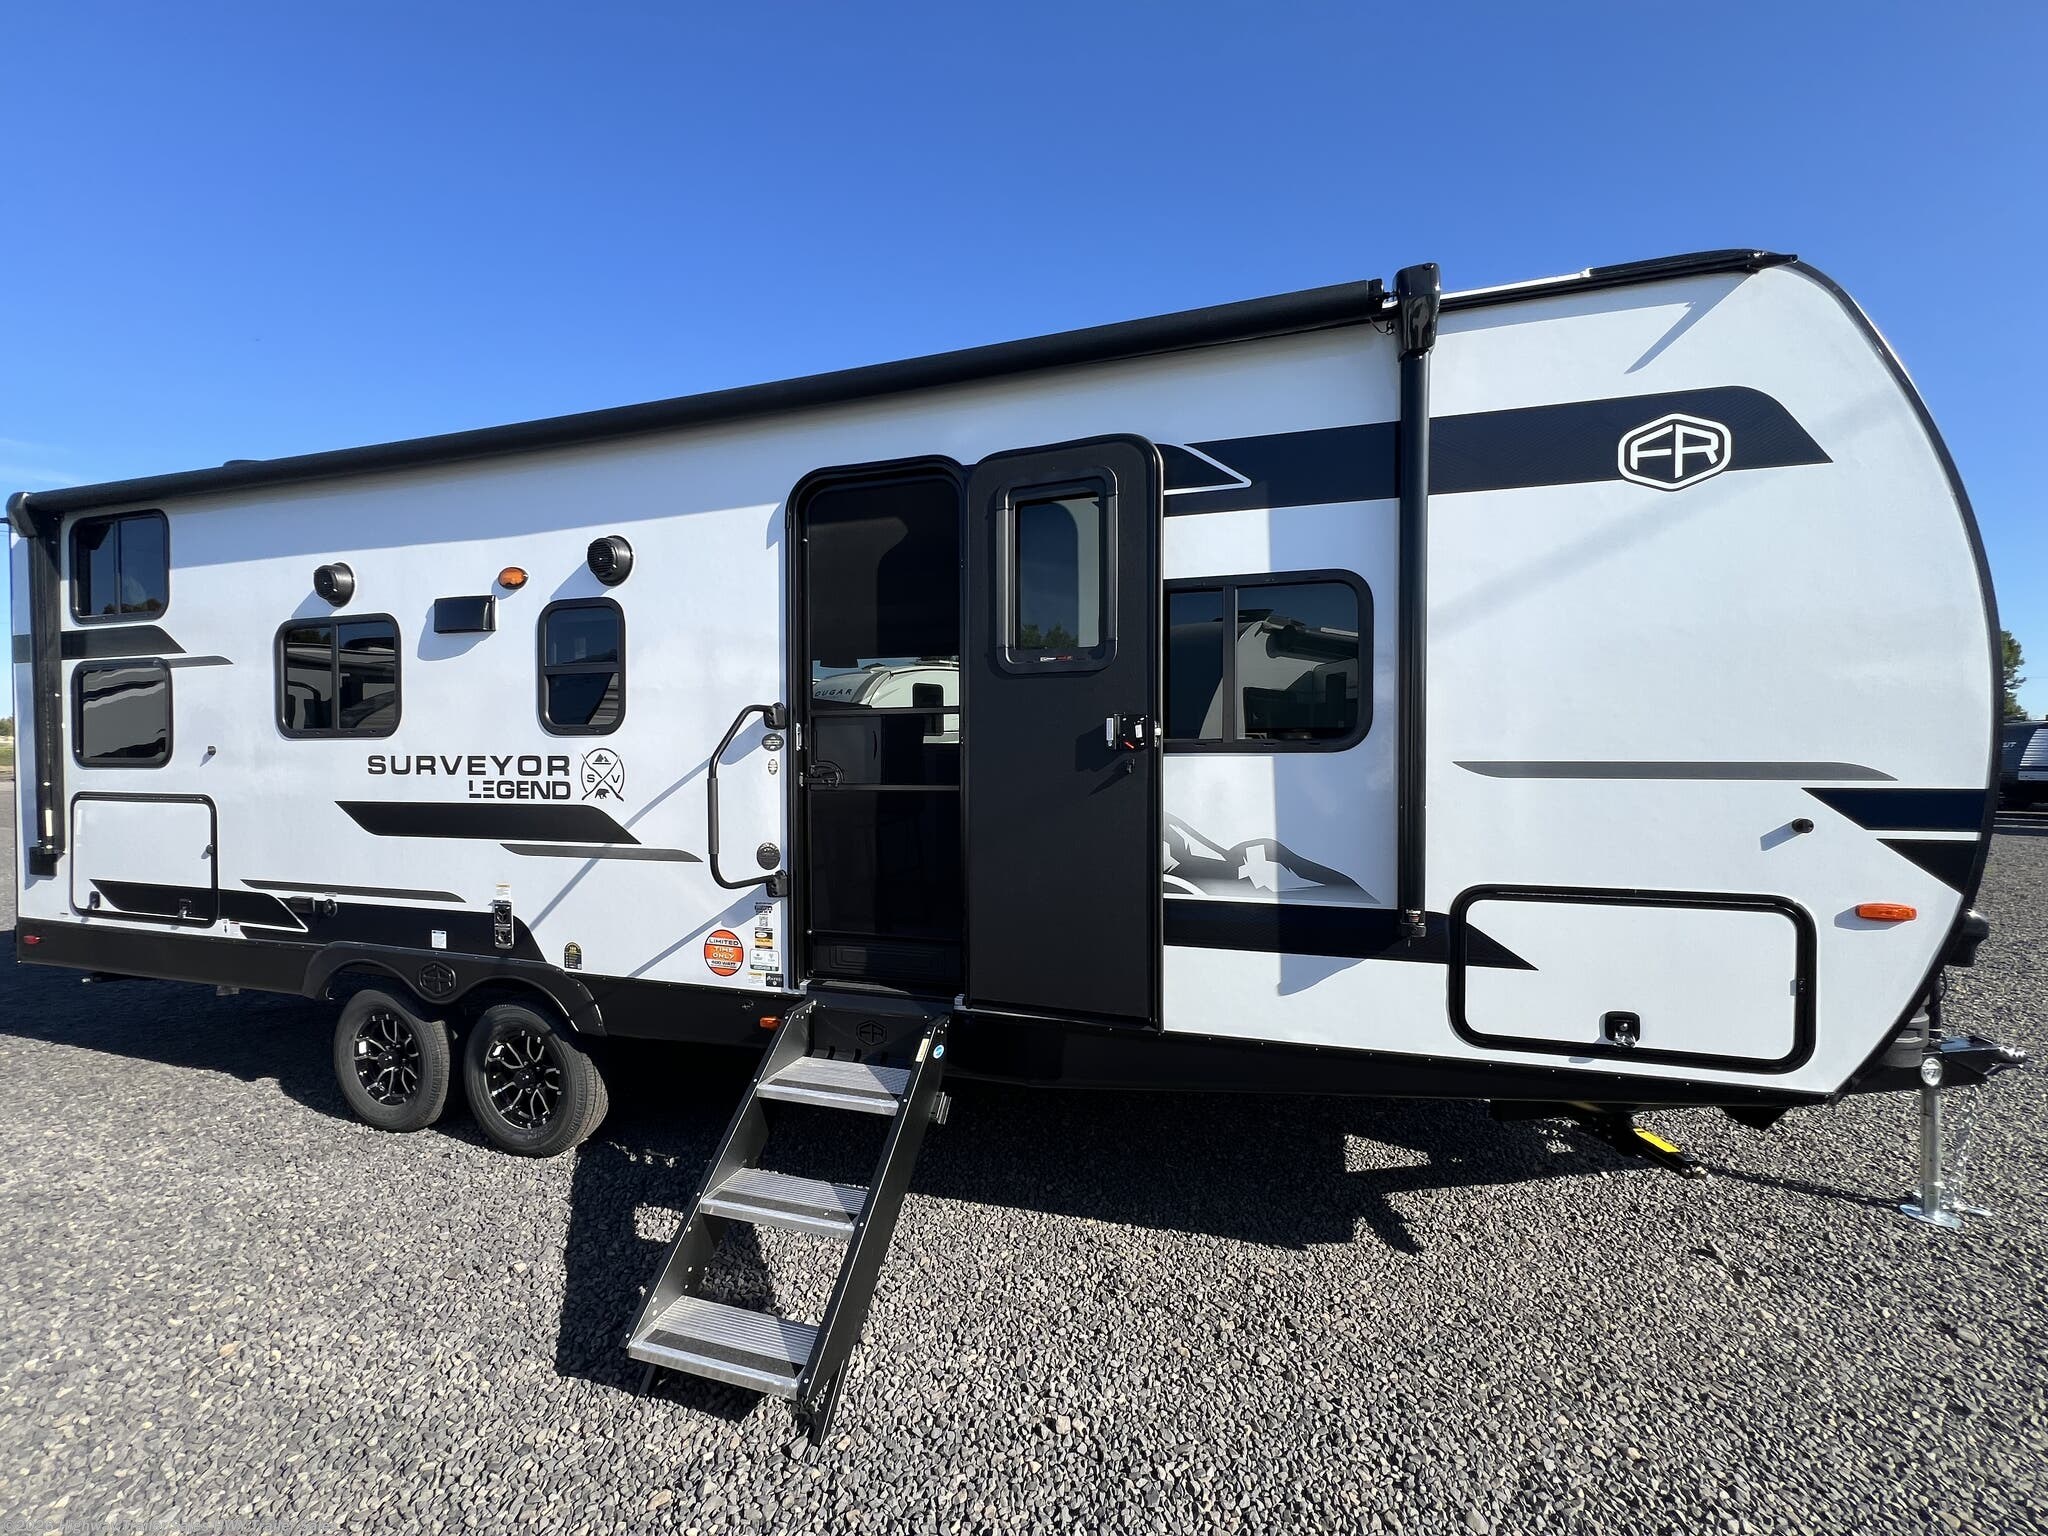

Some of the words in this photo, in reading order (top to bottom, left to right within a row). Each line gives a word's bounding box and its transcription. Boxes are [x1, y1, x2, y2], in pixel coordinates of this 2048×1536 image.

[1630, 424, 1719, 479] FR
[815, 688, 852, 697] OUGAR
[367, 755, 570, 776] SURVEYOR
[586, 773, 595, 783] S
[611, 774, 621, 784] V
[468, 780, 571, 800] LEGEND
[712, 952, 735, 960] ONLY
